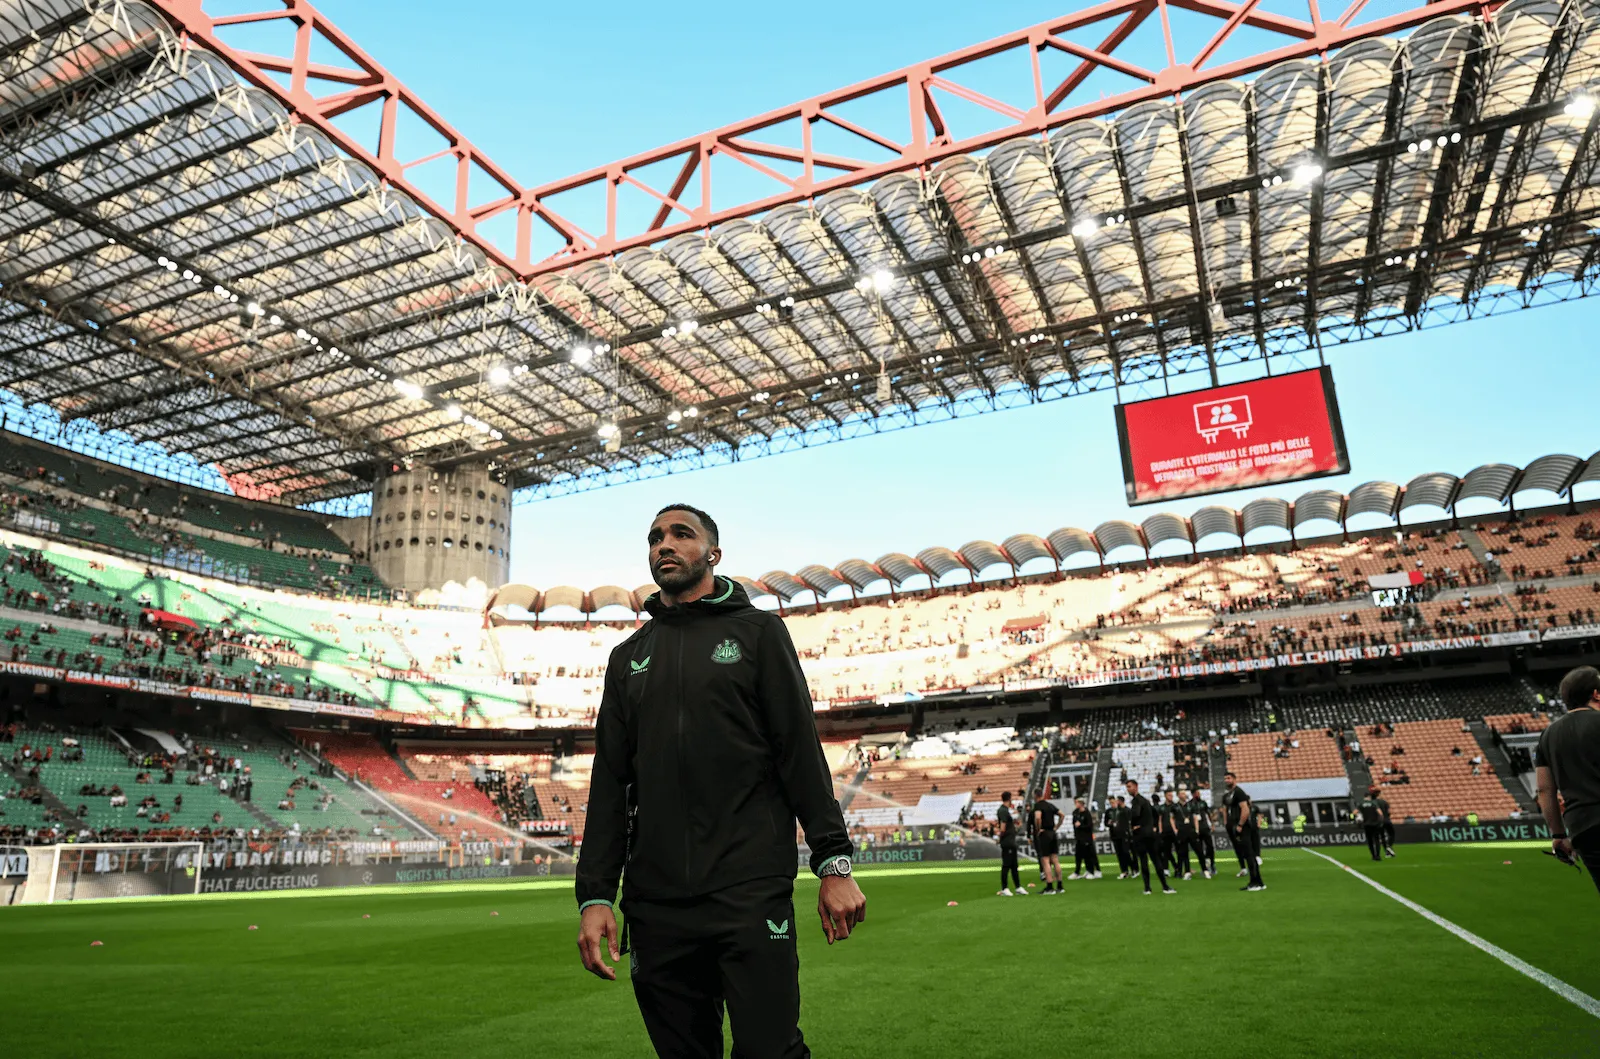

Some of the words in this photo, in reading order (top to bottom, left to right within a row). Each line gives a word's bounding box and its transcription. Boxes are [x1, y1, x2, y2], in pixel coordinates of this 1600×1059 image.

[1238, 447, 1248, 458] LE
[1249, 443, 1269, 457] FOTO
[1286, 436, 1311, 450] BELLE
[1195, 460, 1237, 476] MOSTRATE
[1365, 644, 1397, 659] 1973
[520, 821, 567, 832] ARCORE
[1430, 824, 1498, 841] NIGHTS
[1500, 824, 1531, 839] WE
[1260, 834, 1326, 846] CHAMPIONS
[1329, 832, 1366, 844] LEAGU
[235, 851, 275, 867] DAY
[851, 851, 873, 863] VER
[876, 848, 924, 862] FORGET
[396, 868, 432, 882] NIGHTS
[433, 867, 448, 880] WE
[450, 866, 478, 880] NEVER
[479, 865, 513, 879] FORGET
[235, 874, 319, 890] #UCLFEELING
